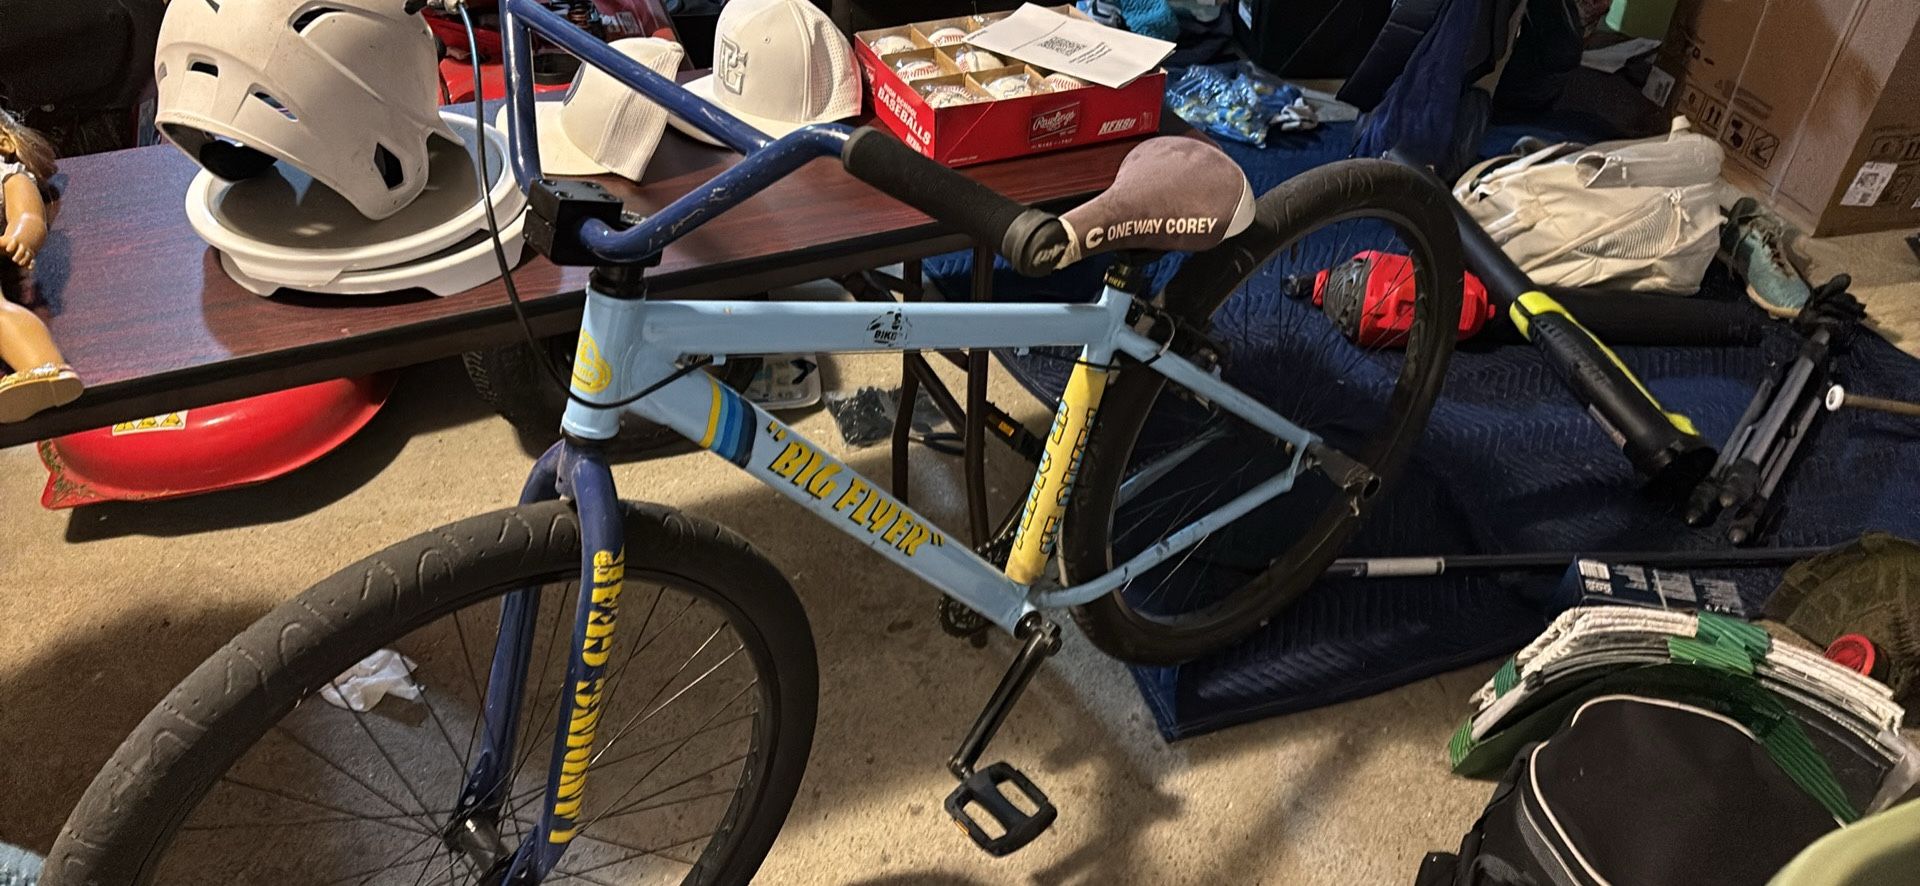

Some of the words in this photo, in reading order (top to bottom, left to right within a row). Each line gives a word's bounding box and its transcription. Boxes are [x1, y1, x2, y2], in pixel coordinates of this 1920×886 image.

[877, 86, 932, 146] BASEBALLS
[896, 95, 918, 119] SCHOOL
[1032, 110, 1076, 132] Rawlings
[1107, 218, 1163, 242] ONEWAY
[1165, 217, 1218, 235] COREY
[548, 678, 605, 844] LANDING
[582, 543, 626, 667] GEAR
